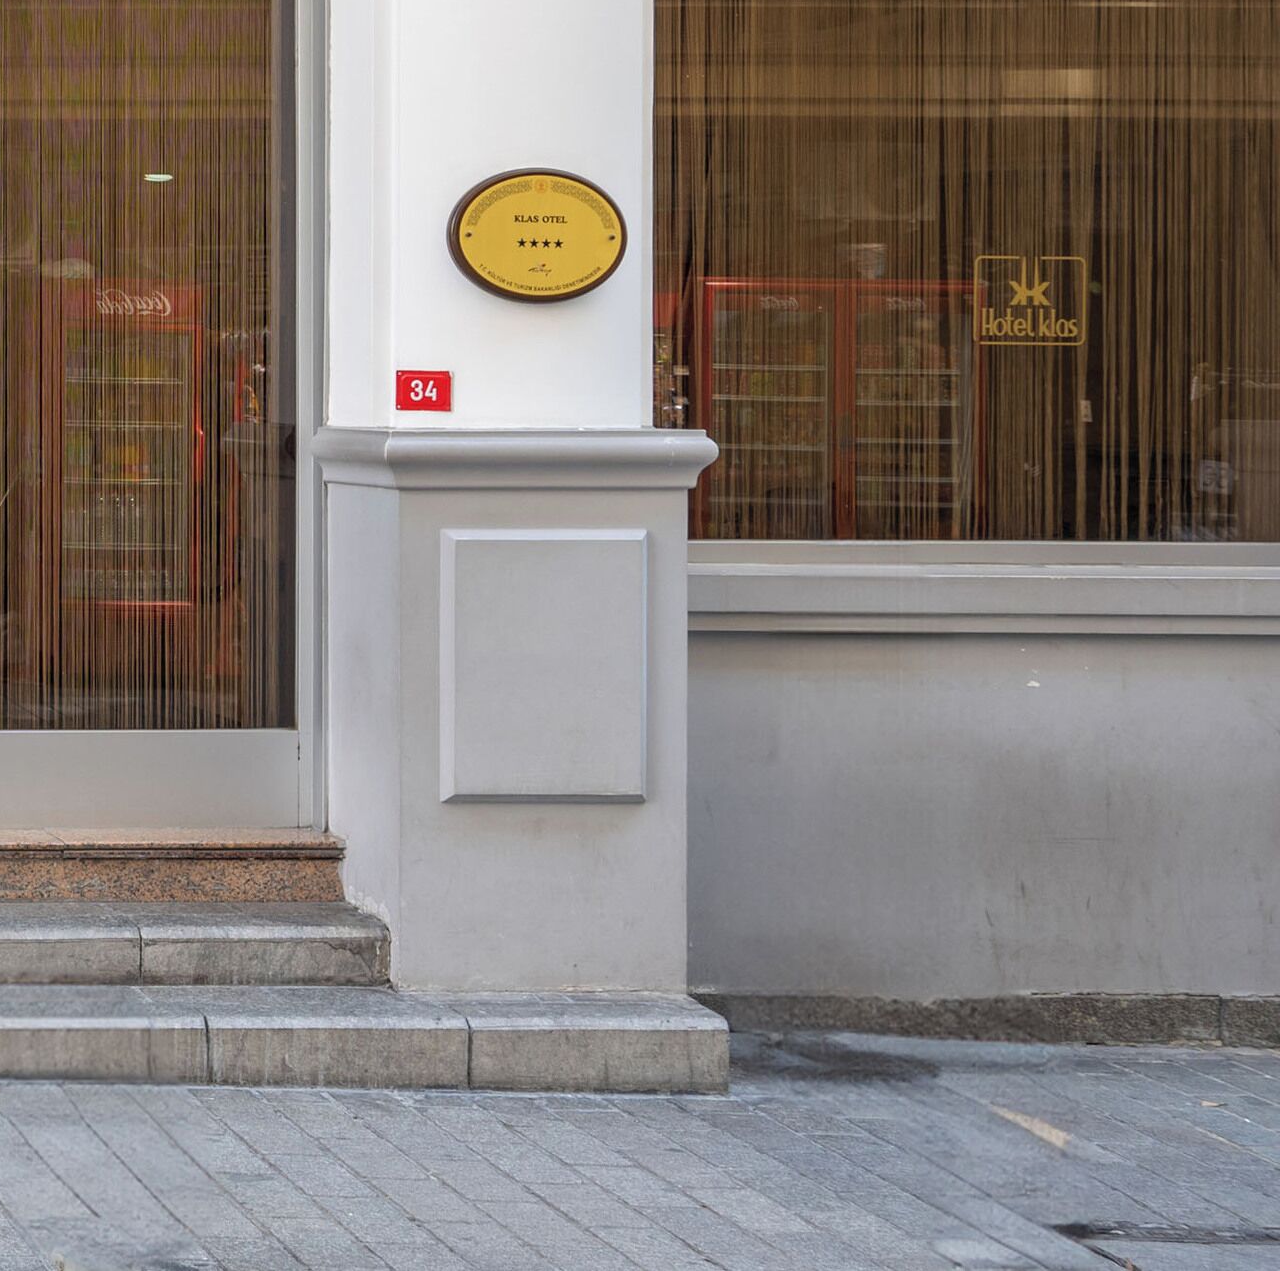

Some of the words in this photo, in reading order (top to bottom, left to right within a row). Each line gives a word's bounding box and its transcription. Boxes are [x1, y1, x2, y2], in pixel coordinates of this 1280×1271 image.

[514, 214, 539, 223] KLAS
[542, 215, 568, 224] OTEL
[981, 308, 1035, 337] Hotel
[1040, 309, 1078, 338] klas
[410, 379, 437, 402] 34
